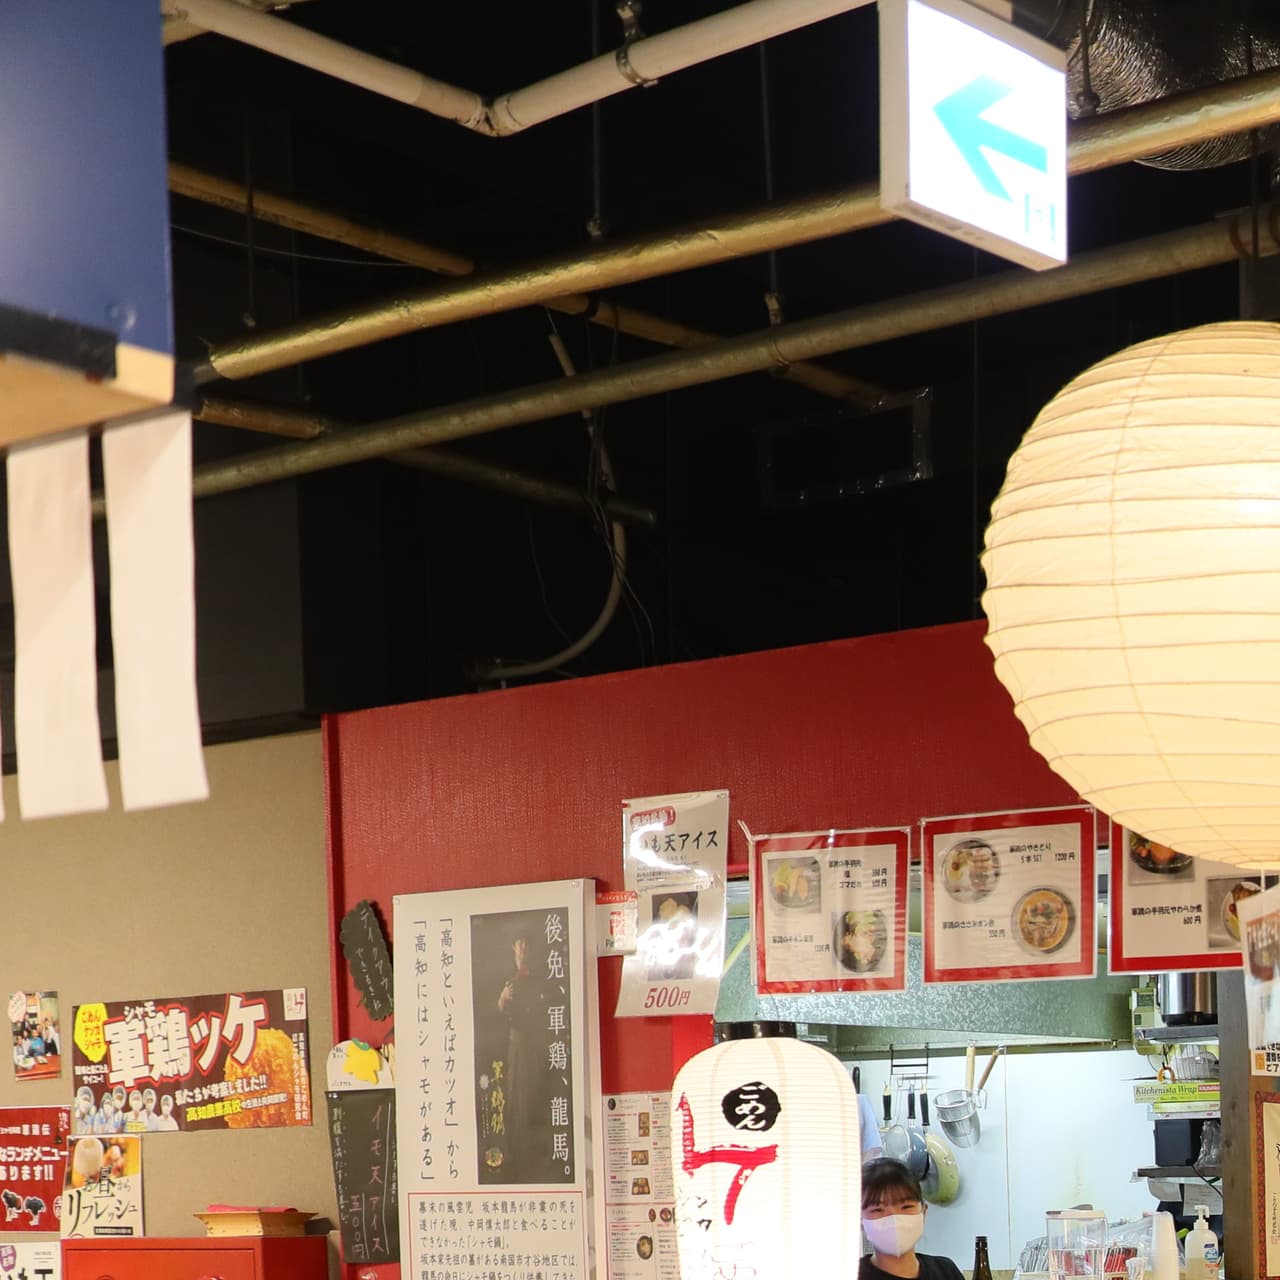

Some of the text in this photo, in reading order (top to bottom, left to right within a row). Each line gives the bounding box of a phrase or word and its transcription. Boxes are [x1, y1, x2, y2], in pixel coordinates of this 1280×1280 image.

[124, 1002, 156, 1021] シャモ
[413, 920, 435, 1181] 「高知にはシャモがある」
[439, 919, 460, 1179] 「高知といえばカツオ」から
[544, 913, 571, 1176] 後免、軍鶏、龍馬。
[643, 986, 690, 1009] 500円
[369, 1106, 384, 1253] イモ天アイス
[736, 1083, 767, 1130] ごめん
